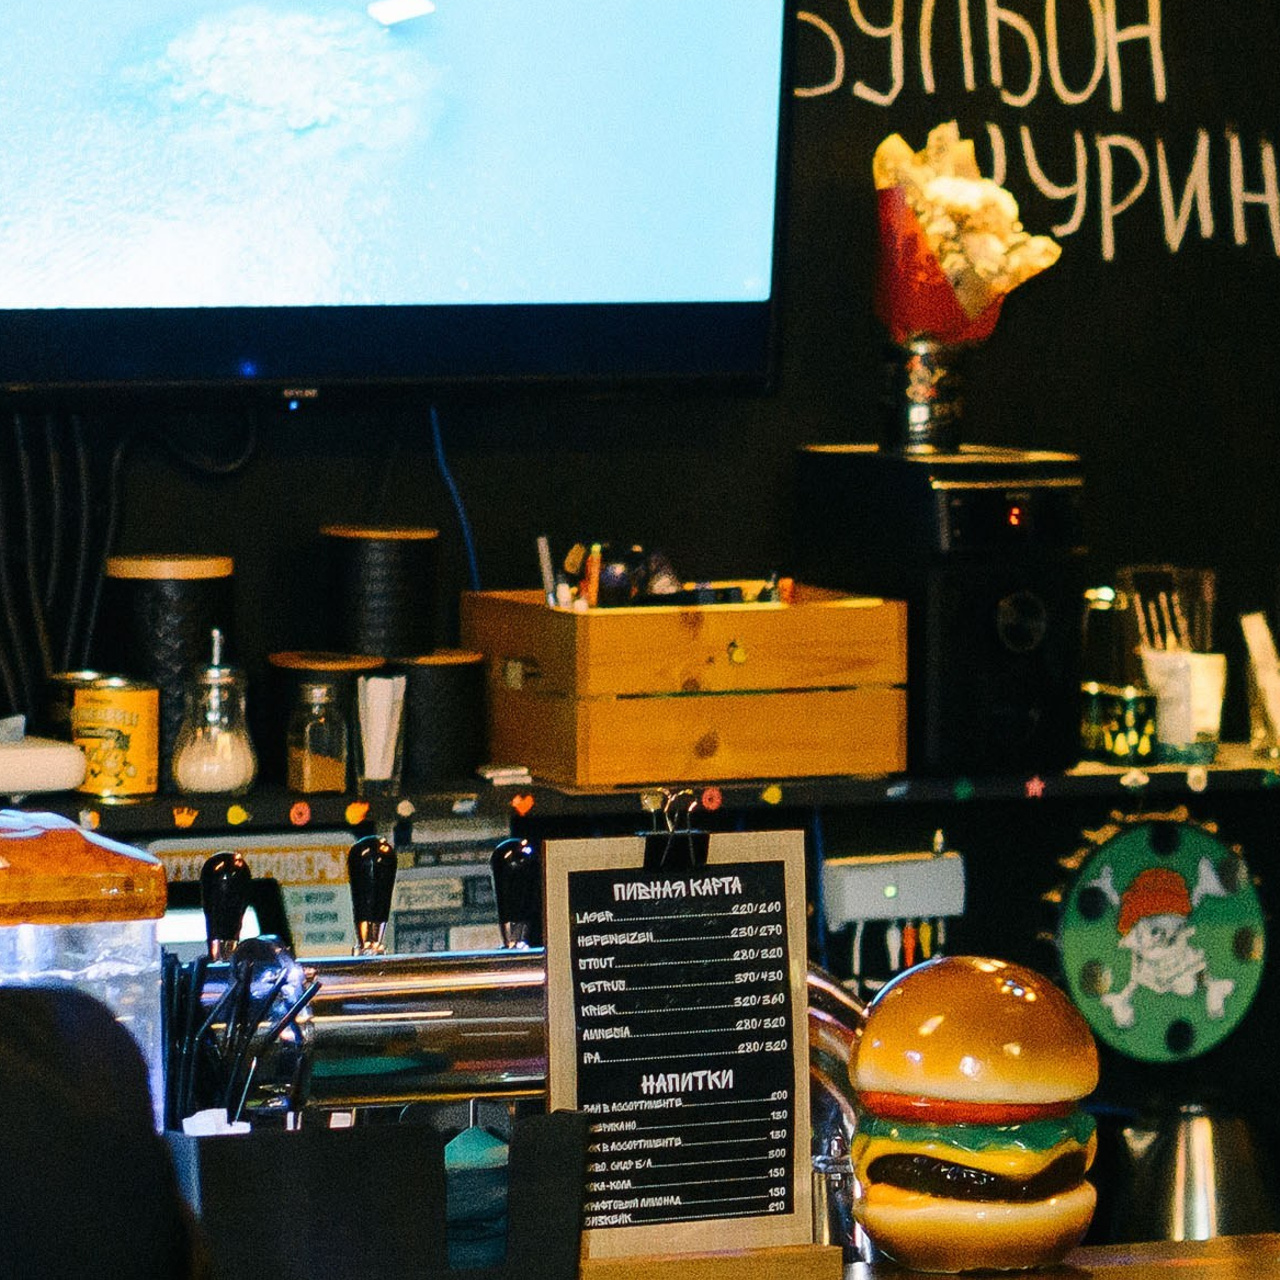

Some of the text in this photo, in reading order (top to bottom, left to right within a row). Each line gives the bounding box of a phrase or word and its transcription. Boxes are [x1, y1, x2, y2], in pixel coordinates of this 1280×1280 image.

[613, 876, 743, 901] ПИВНАЯ КАРТА
[731, 901, 781, 915] 220/260
[730, 924, 783, 938] 230/270
[578, 947, 783, 970] STOUT 280/320
[580, 980, 626, 993] PETRUS
[733, 993, 785, 1007] 320/360
[735, 1016, 786, 1030] 280/320
[737, 1039, 788, 1054] 280/320
[641, 1069, 734, 1095] НАПИТКИ
